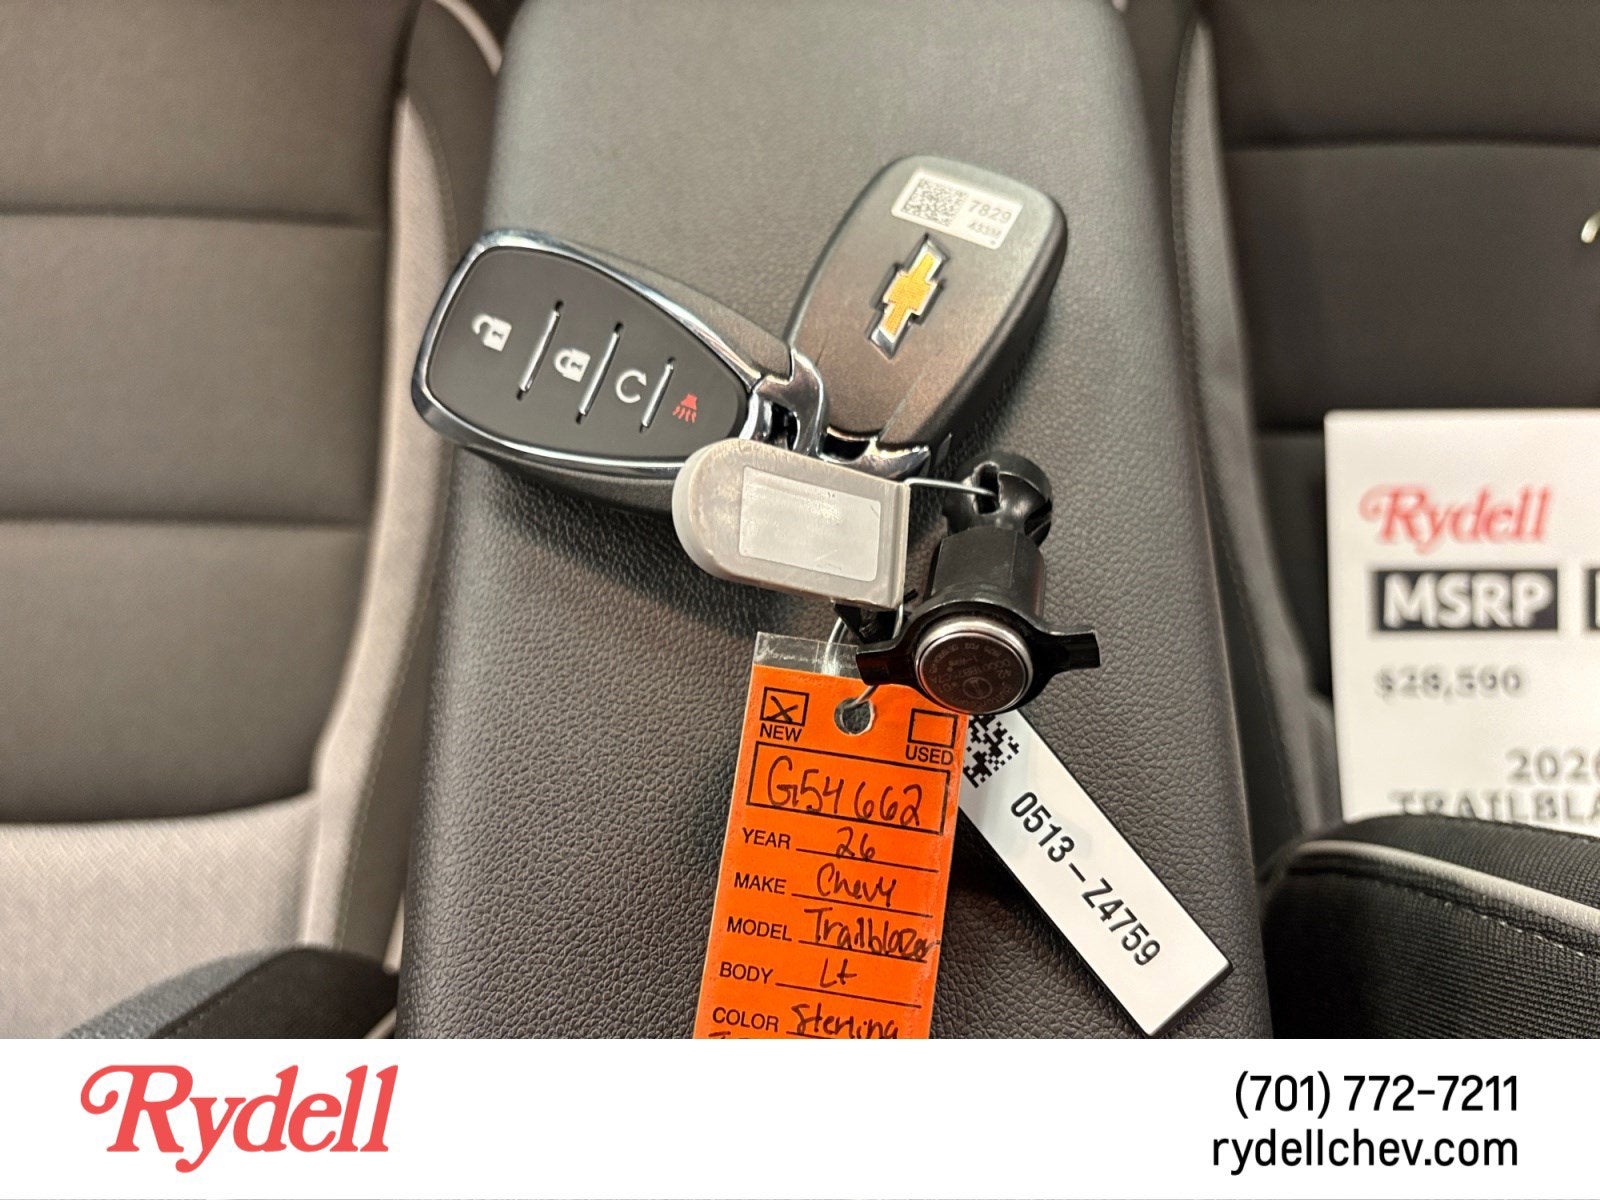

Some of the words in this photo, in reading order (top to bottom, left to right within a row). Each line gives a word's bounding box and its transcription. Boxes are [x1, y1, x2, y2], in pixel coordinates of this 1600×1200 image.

[968, 200, 1012, 223] 7829
[1359, 484, 1551, 554] Rydell
[1383, 572, 1552, 629] MSRP
[759, 723, 802, 742] NEW
[905, 744, 954, 766] USED
[767, 755, 923, 827] G54662
[742, 827, 791, 850] YEAR
[836, 826, 876, 860] 26
[734, 871, 787, 896] MAKE
[726, 915, 793, 942] MODEL
[720, 961, 773, 986] BODY
[712, 1006, 779, 1032] COLOR
